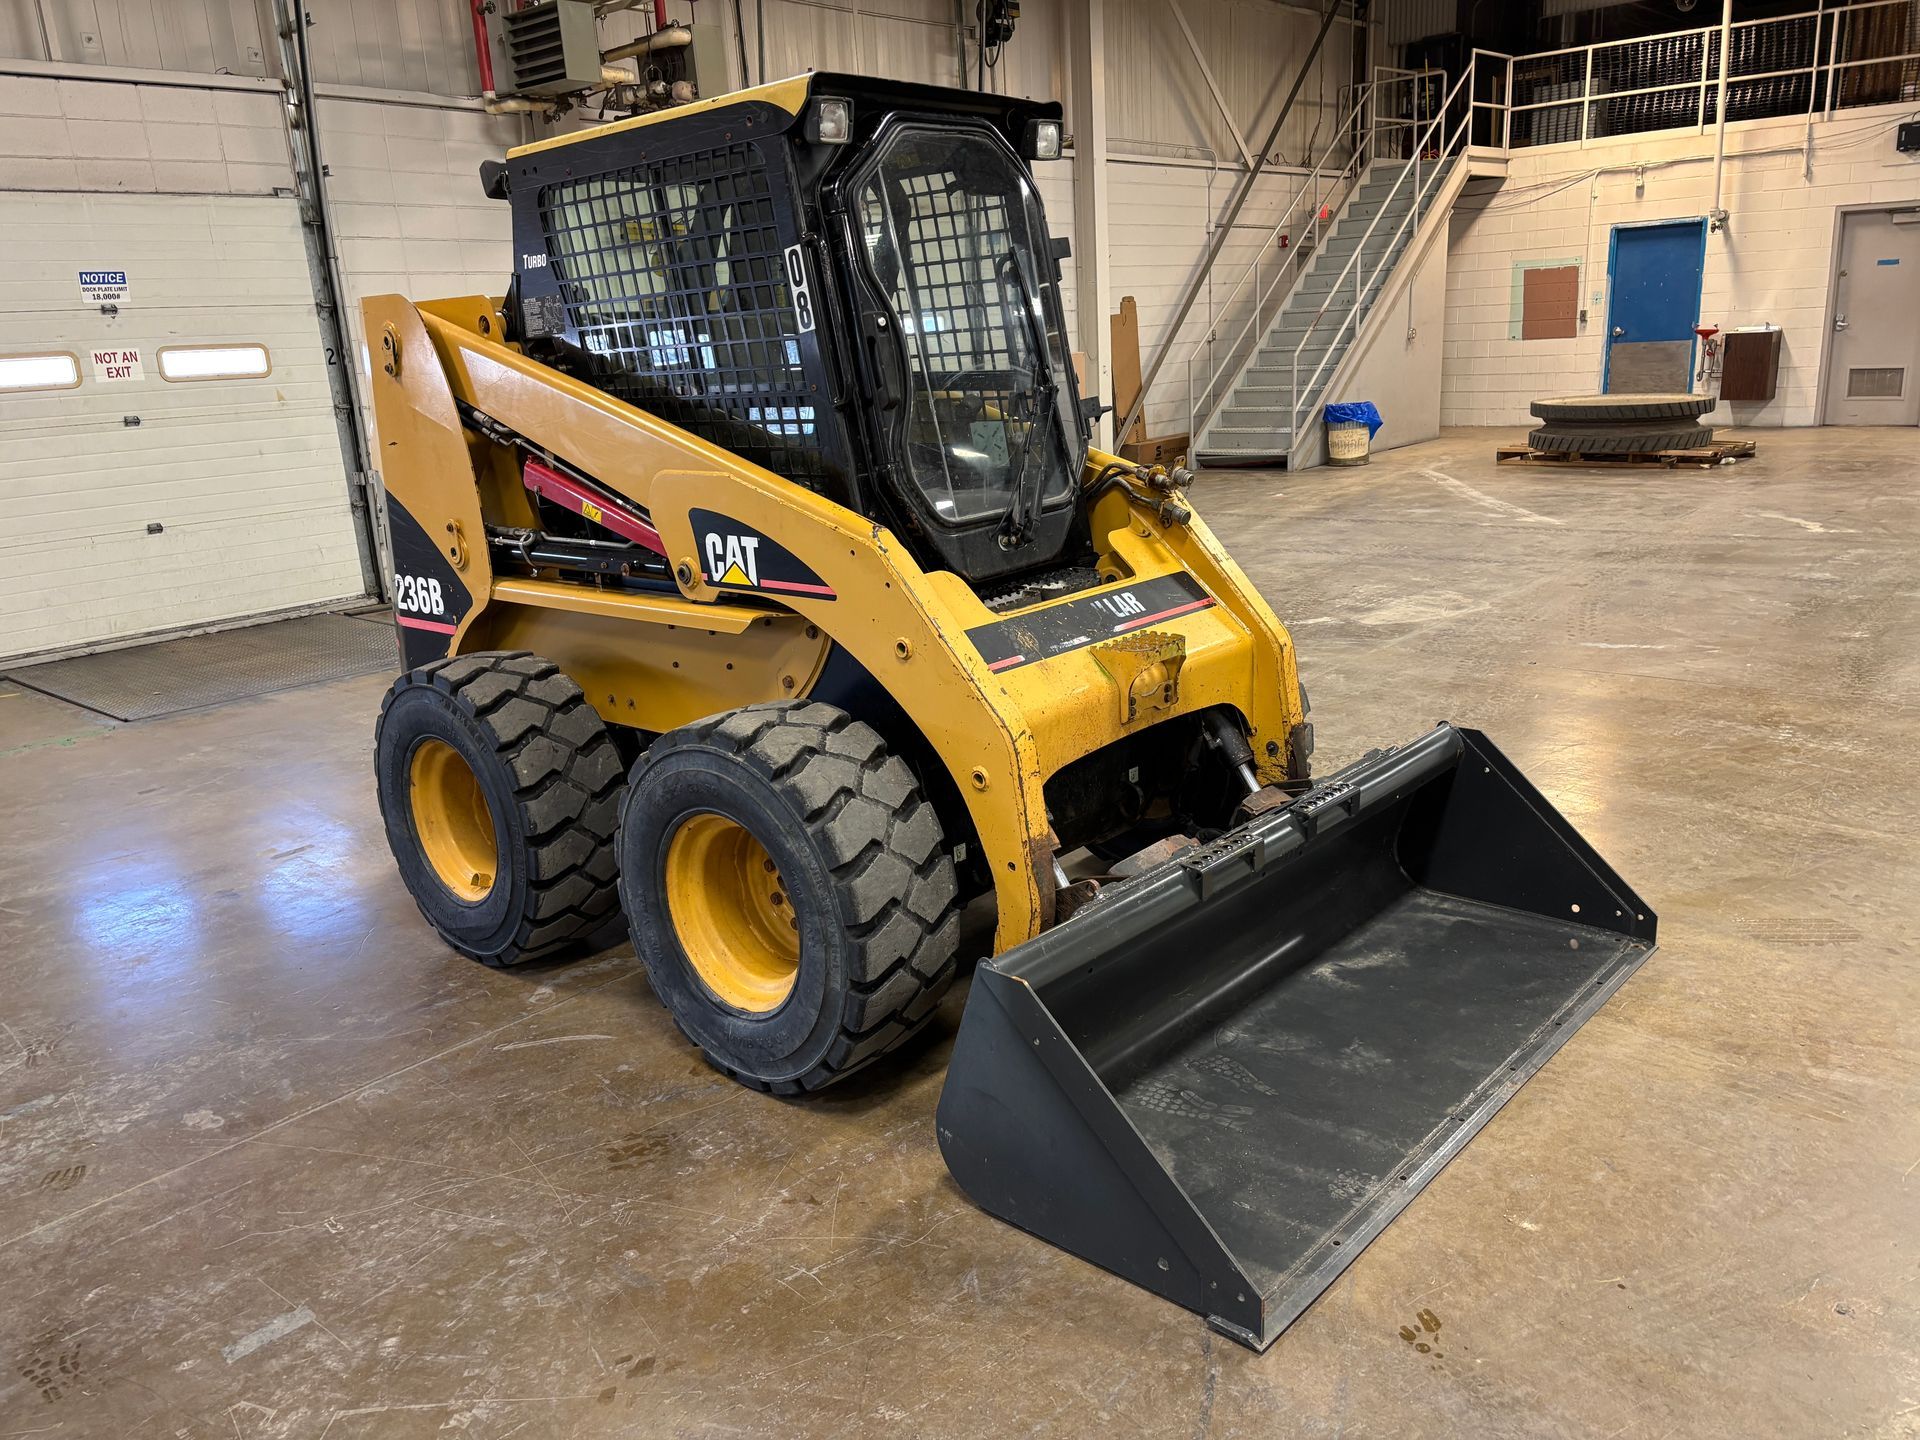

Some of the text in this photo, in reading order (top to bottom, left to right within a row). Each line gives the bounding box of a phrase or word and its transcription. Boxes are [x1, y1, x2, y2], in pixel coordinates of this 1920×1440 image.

[82, 273, 124, 283] NOTICE
[788, 249, 812, 329] 08
[94, 351, 138, 364] NOT AN
[326, 348, 336, 365] 2
[106, 366, 131, 378] EXIT
[705, 532, 759, 587] CAT
[395, 573, 444, 615] 236B
